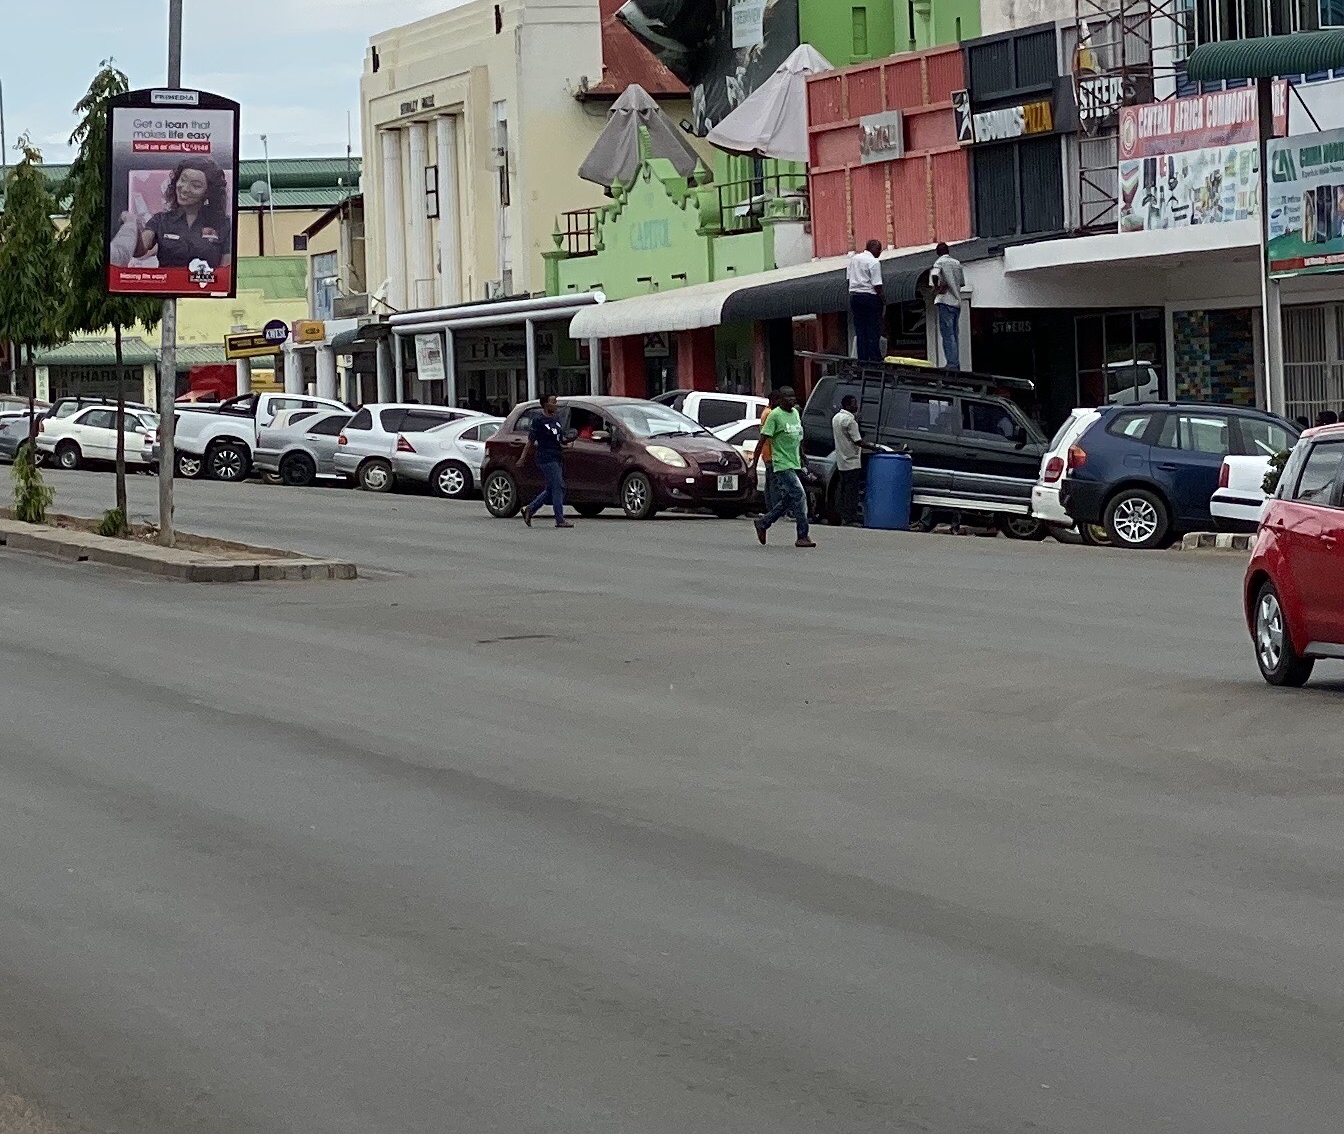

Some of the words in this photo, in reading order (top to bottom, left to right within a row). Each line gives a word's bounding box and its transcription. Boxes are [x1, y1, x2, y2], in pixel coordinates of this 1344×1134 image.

[165, 119, 189, 129] loan
[1137, 103, 1171, 139] CENTRAL
[1174, 97, 1204, 134] AFRICA
[168, 129, 185, 139] life
[186, 130, 212, 141] easy
